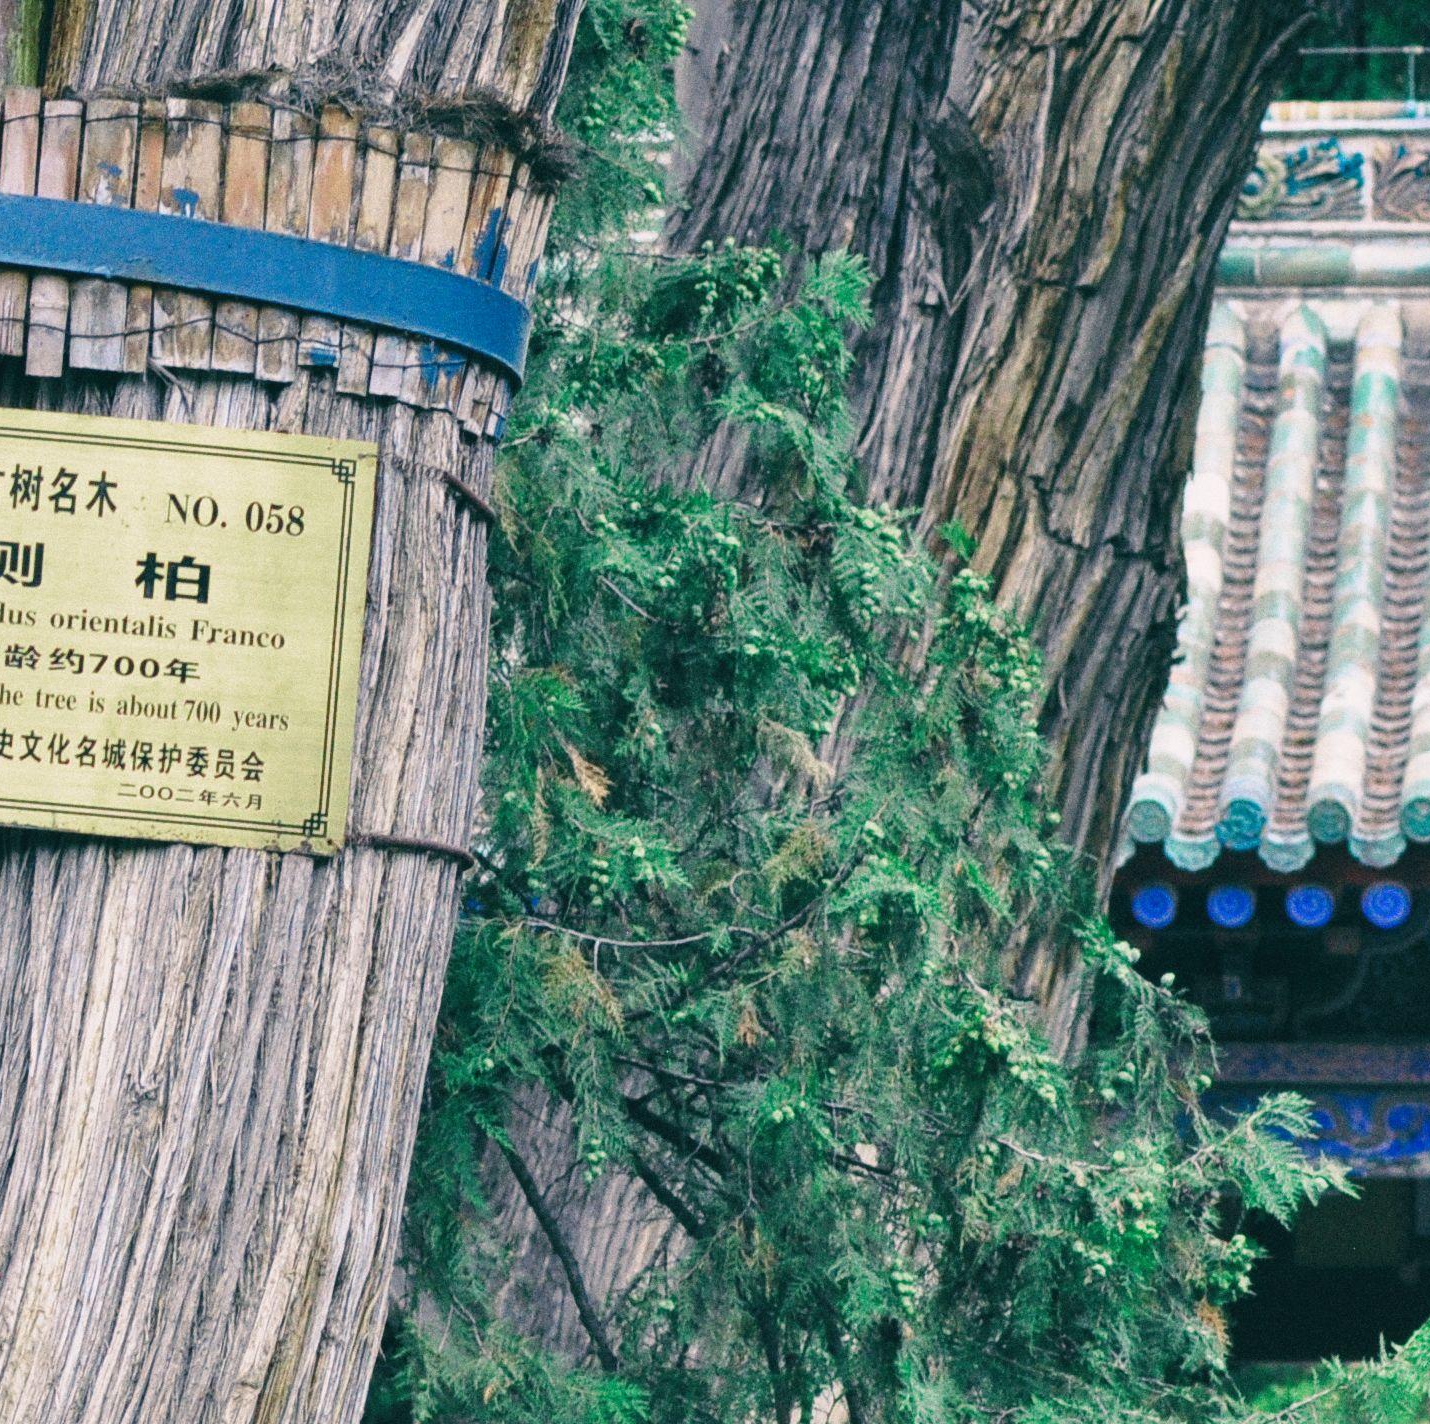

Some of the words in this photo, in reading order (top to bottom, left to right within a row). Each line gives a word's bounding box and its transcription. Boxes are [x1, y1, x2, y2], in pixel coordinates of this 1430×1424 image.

[164, 492, 227, 528] NO.
[245, 501, 305, 536] 058
[49, 608, 177, 639] orientalis
[190, 618, 286, 649] Franco
[35, 688, 77, 710] tree
[88, 690, 105, 713] is
[116, 695, 177, 720] about
[184, 700, 221, 724] 700
[231, 709, 290, 731] years
